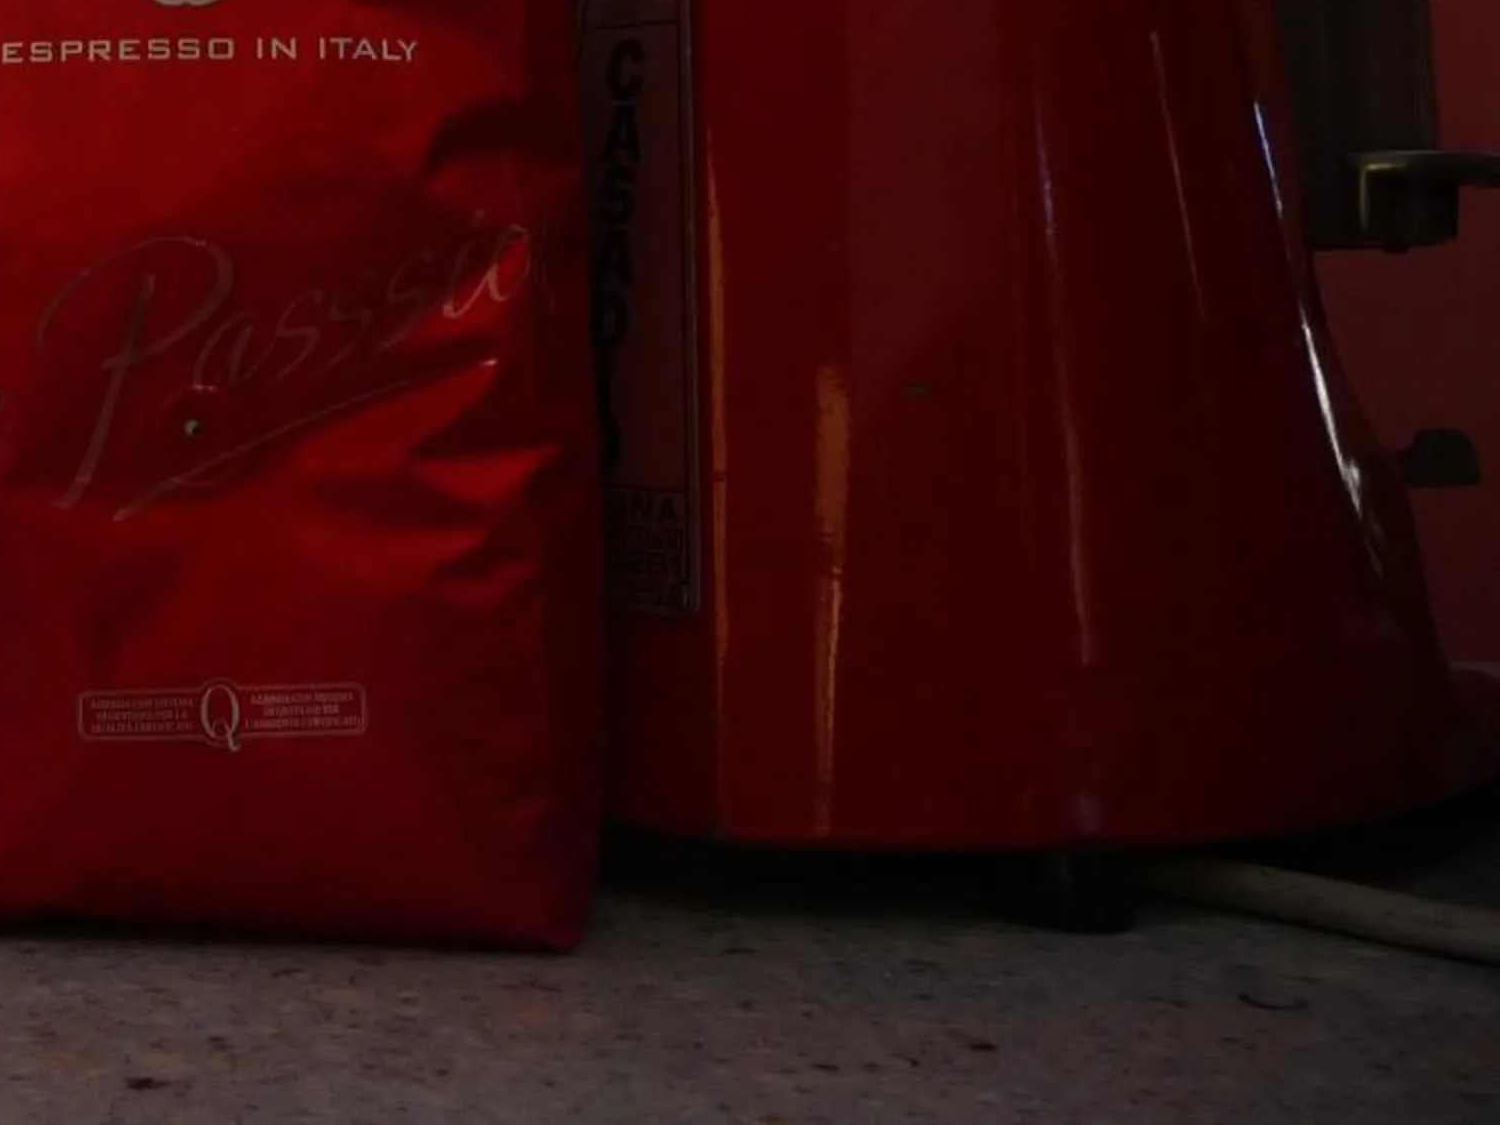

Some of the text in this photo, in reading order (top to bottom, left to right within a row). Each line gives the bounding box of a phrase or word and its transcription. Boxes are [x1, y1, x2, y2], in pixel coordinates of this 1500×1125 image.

[1, 36, 419, 65] ESPRESSO IN ITALY
